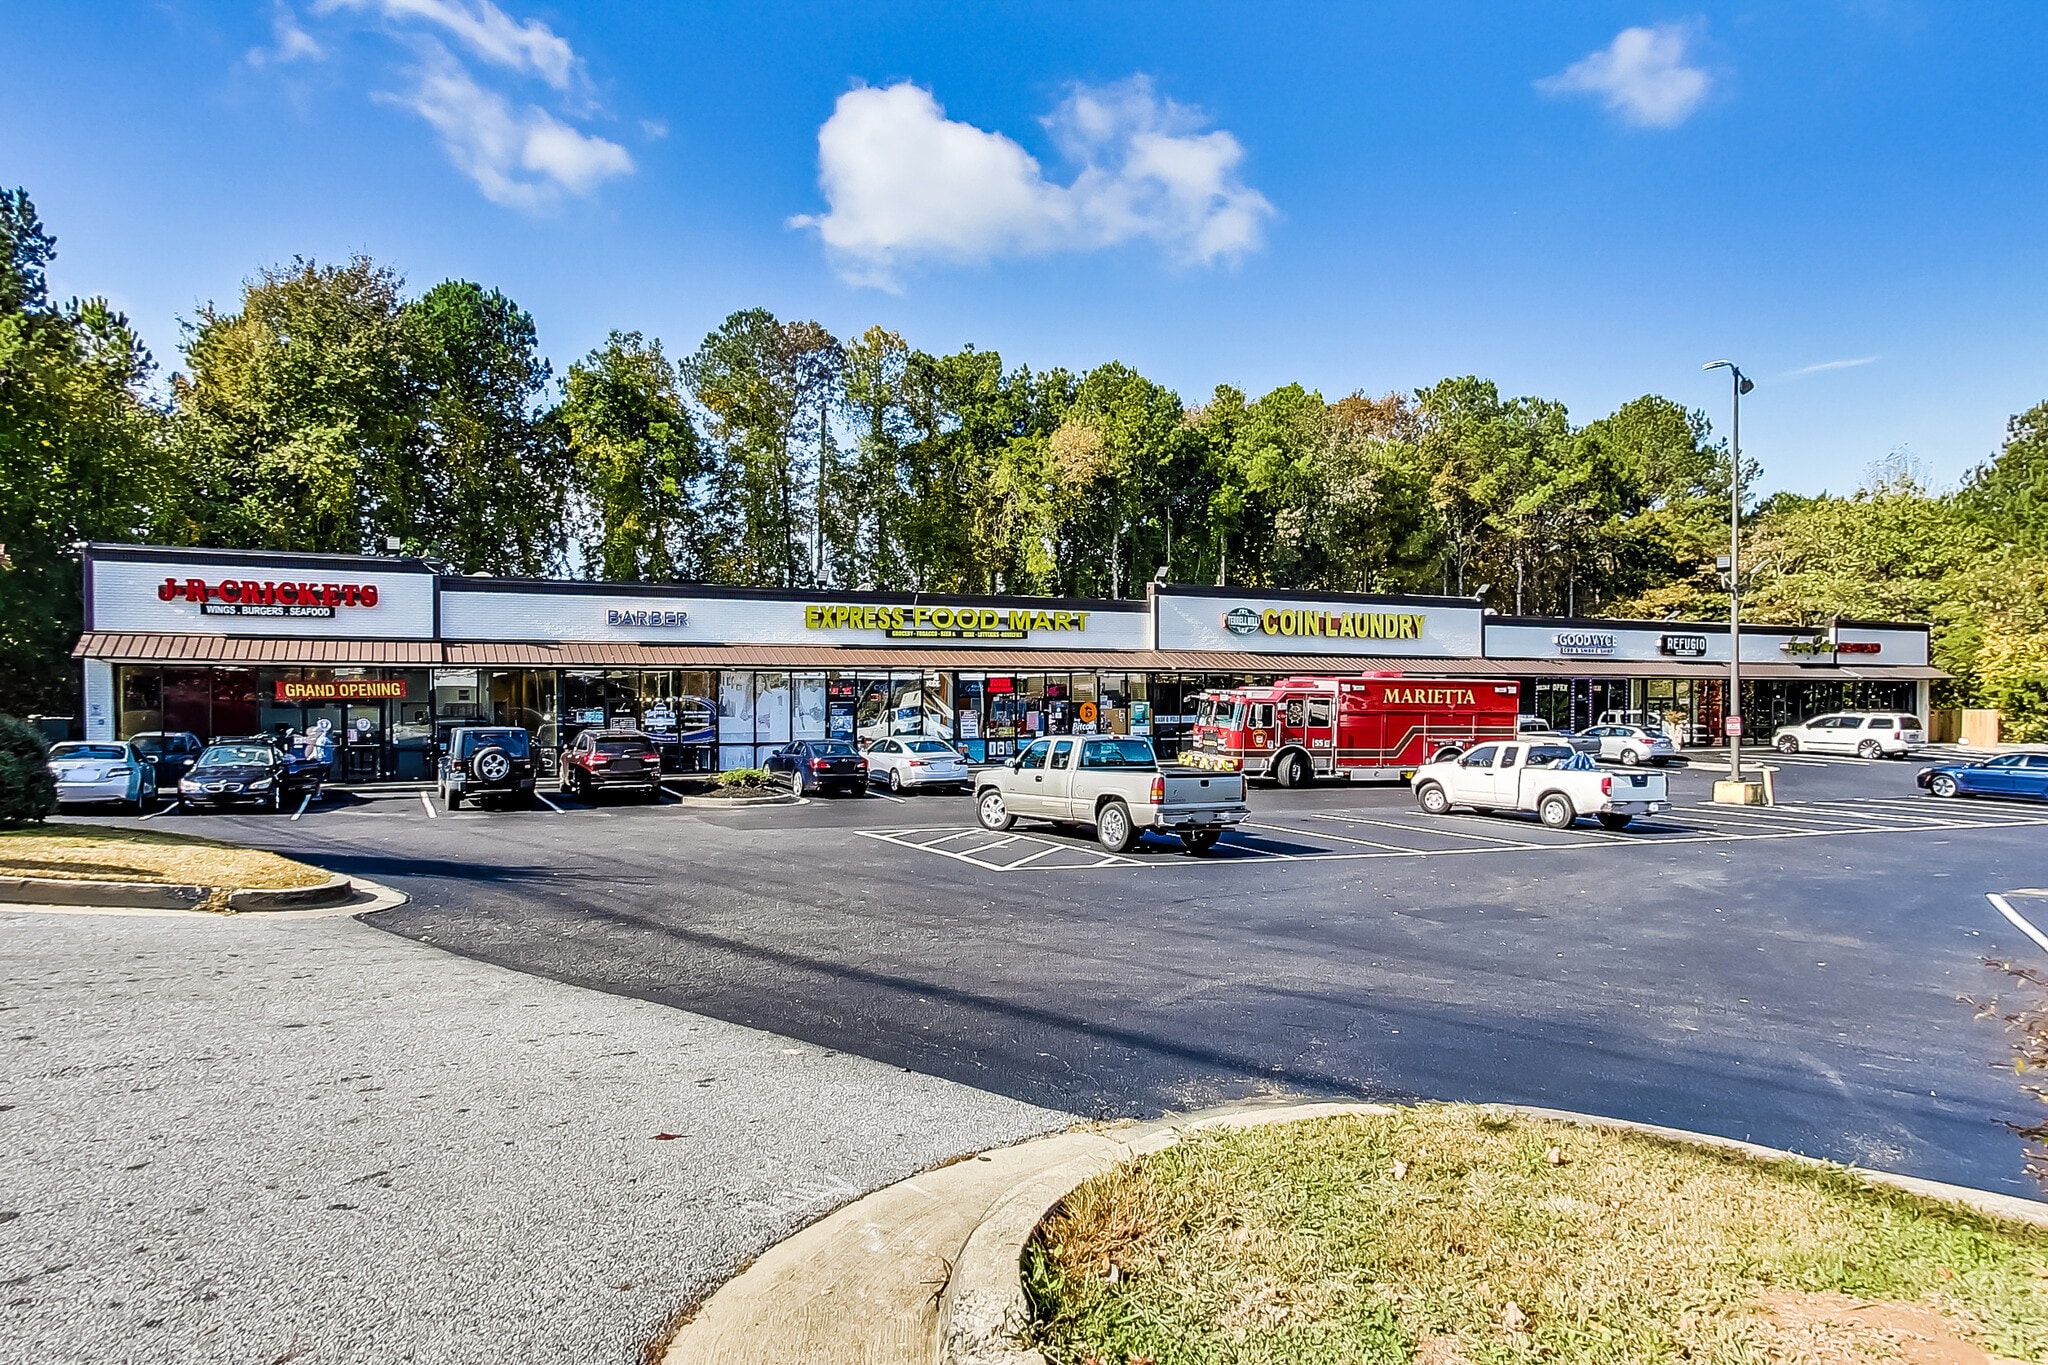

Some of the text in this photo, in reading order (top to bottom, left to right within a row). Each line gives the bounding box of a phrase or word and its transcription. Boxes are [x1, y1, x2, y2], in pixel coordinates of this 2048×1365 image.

[206, 605, 329, 617] WINGS BURGERS SEAFOOD
[607, 609, 689, 626] BARBER
[805, 605, 1090, 631] EXPRESS FOOD MART
[1262, 608, 1426, 638] COIN LAUNDRY
[1667, 637, 1705, 650] REFUGIO
[285, 682, 401, 697] GRAND OPENING
[1382, 688, 1476, 704] MARIETTA
[1072, 722, 1097, 731] Bitcoin
